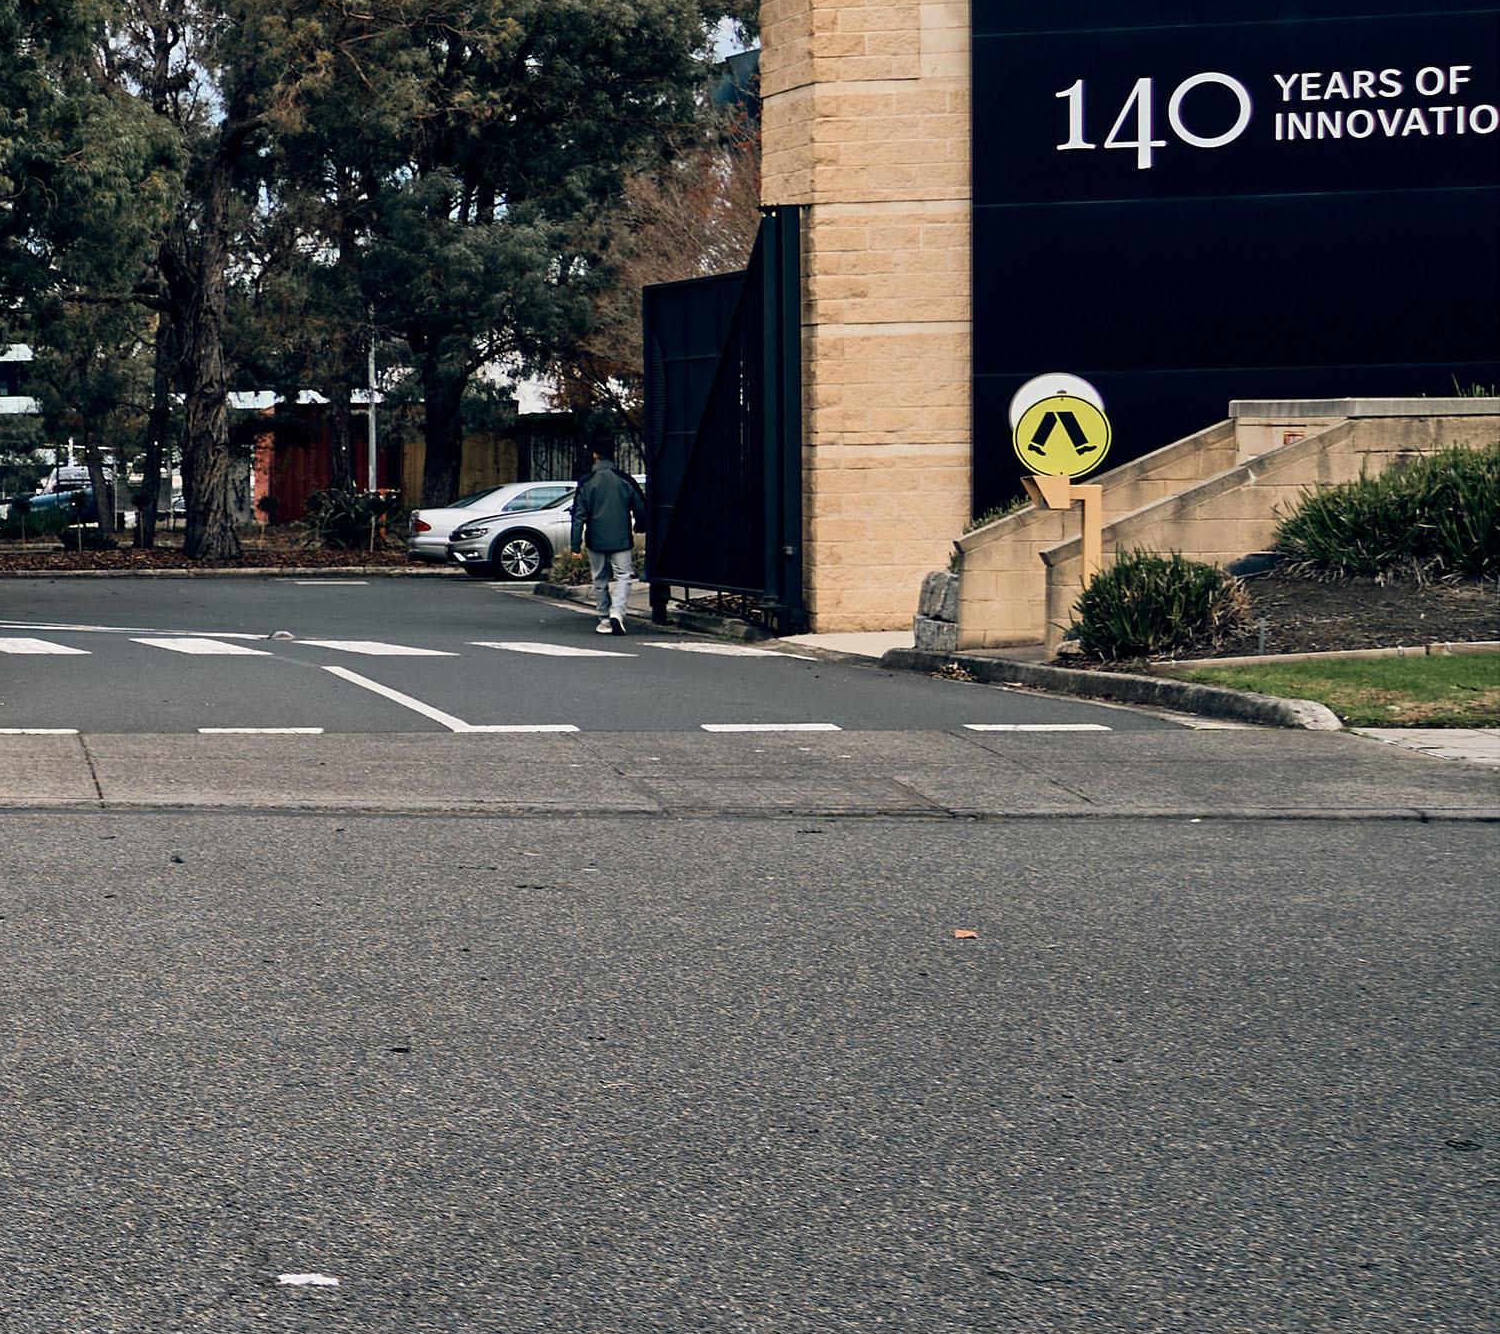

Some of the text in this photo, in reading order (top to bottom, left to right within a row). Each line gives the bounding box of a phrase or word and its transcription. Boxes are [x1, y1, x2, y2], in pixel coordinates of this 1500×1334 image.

[1273, 65, 1472, 102] YEARS OF
[1055, 71, 1253, 170] 140
